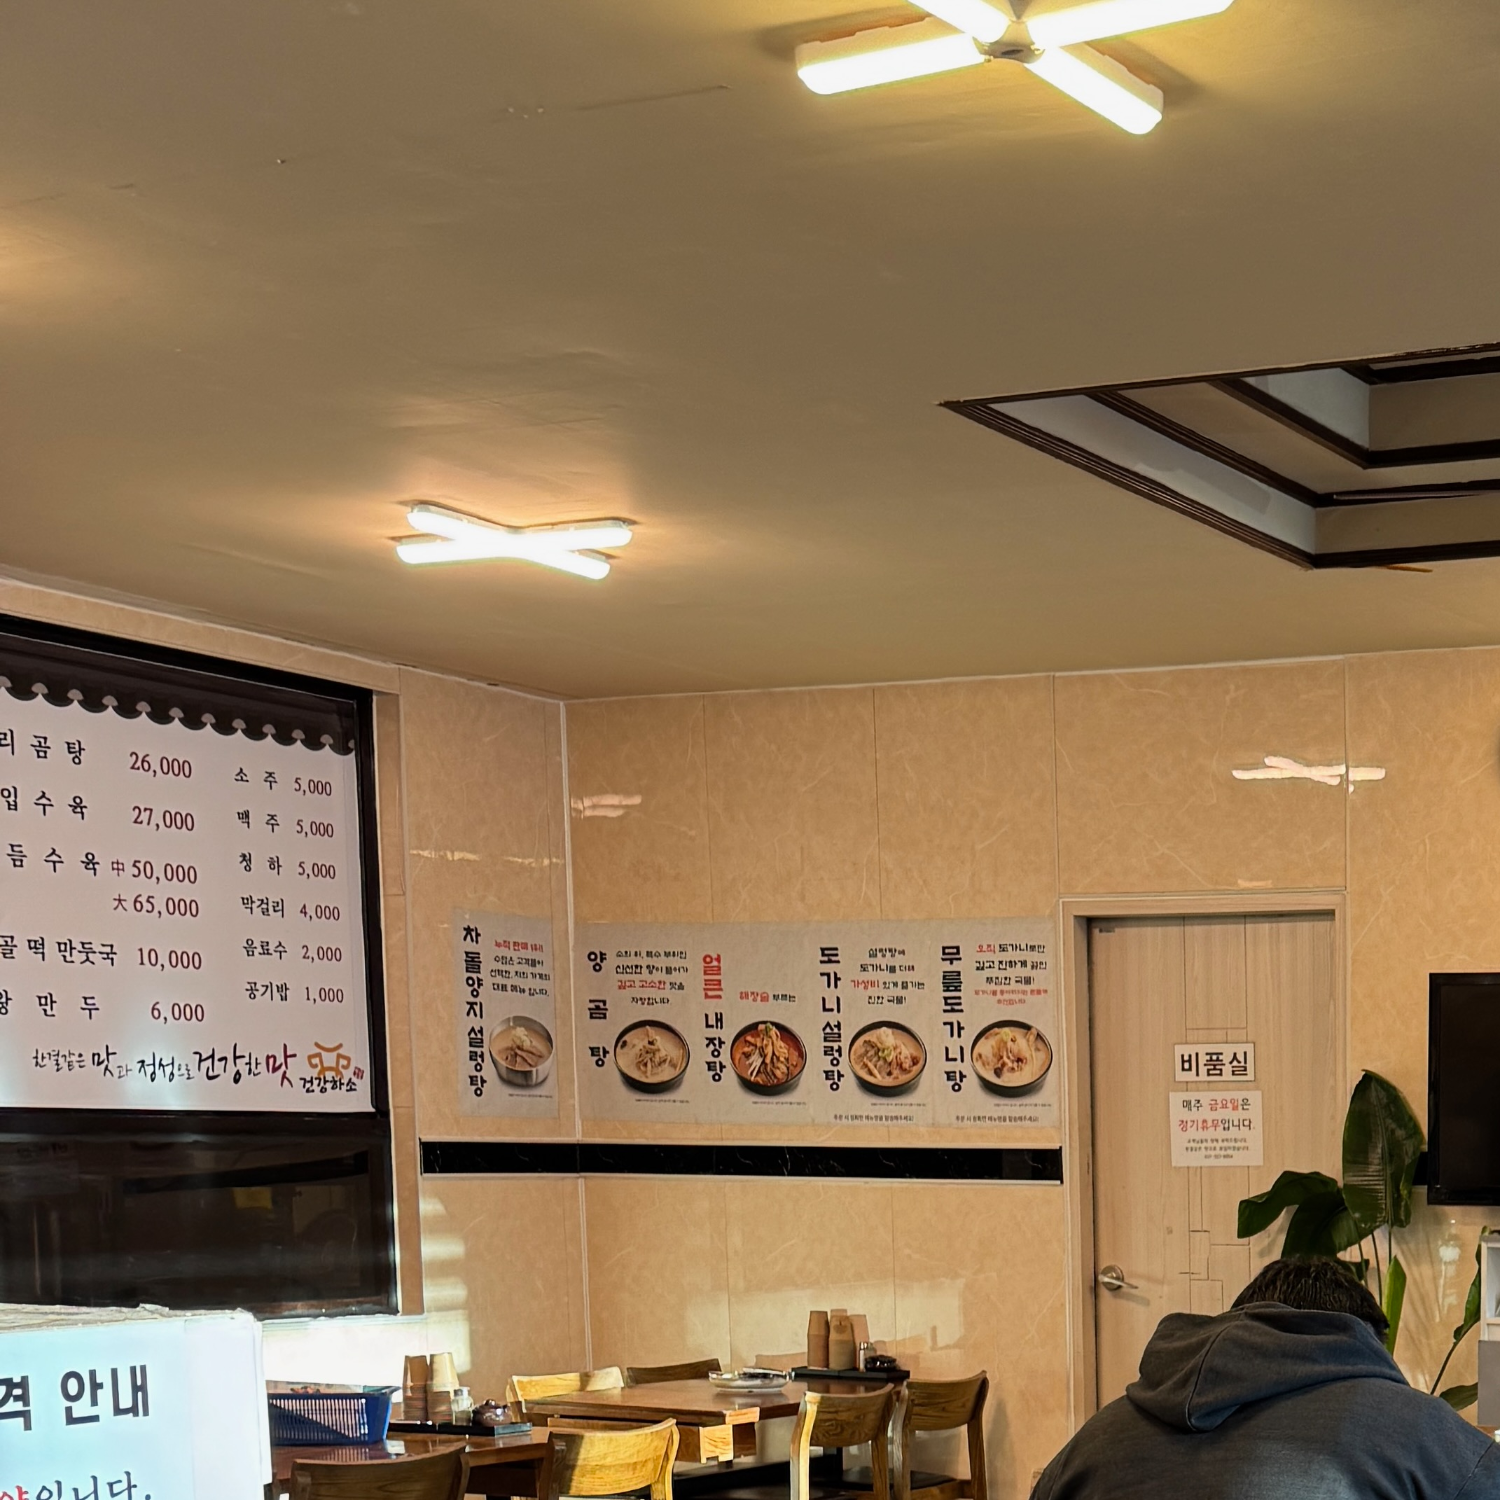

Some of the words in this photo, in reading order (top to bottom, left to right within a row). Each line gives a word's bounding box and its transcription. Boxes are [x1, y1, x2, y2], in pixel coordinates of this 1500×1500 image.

[129, 752, 192, 780] 26,000
[294, 777, 332, 797] 5,000
[132, 806, 195, 833] 27,000
[296, 820, 334, 839] 5,000
[111, 860, 125, 877] 中
[131, 860, 197, 885] 50,000
[298, 861, 336, 880] 5,000
[113, 894, 128, 912] 大
[133, 894, 199, 920] 65,000
[241, 895, 285, 918] 막걸리
[300, 904, 341, 922] 4,000
[137, 947, 202, 971] 10,000
[243, 938, 288, 960] 음료수
[301, 945, 342, 964] 2,000
[245, 981, 290, 1003] 공기밥
[304, 987, 344, 1005] 1,000
[151, 1001, 205, 1026] 6,000
[266, 1043, 297, 1088] 맛
[1180, 1051, 1248, 1077] 비품실
[299, 1076, 357, 1094] 건강하소
[1182, 1098, 1203, 1112] 매주
[1208, 1097, 1251, 1112] 금요일은
[0, 1375, 32, 1431] 격
[60, 1364, 150, 1426] 안내
